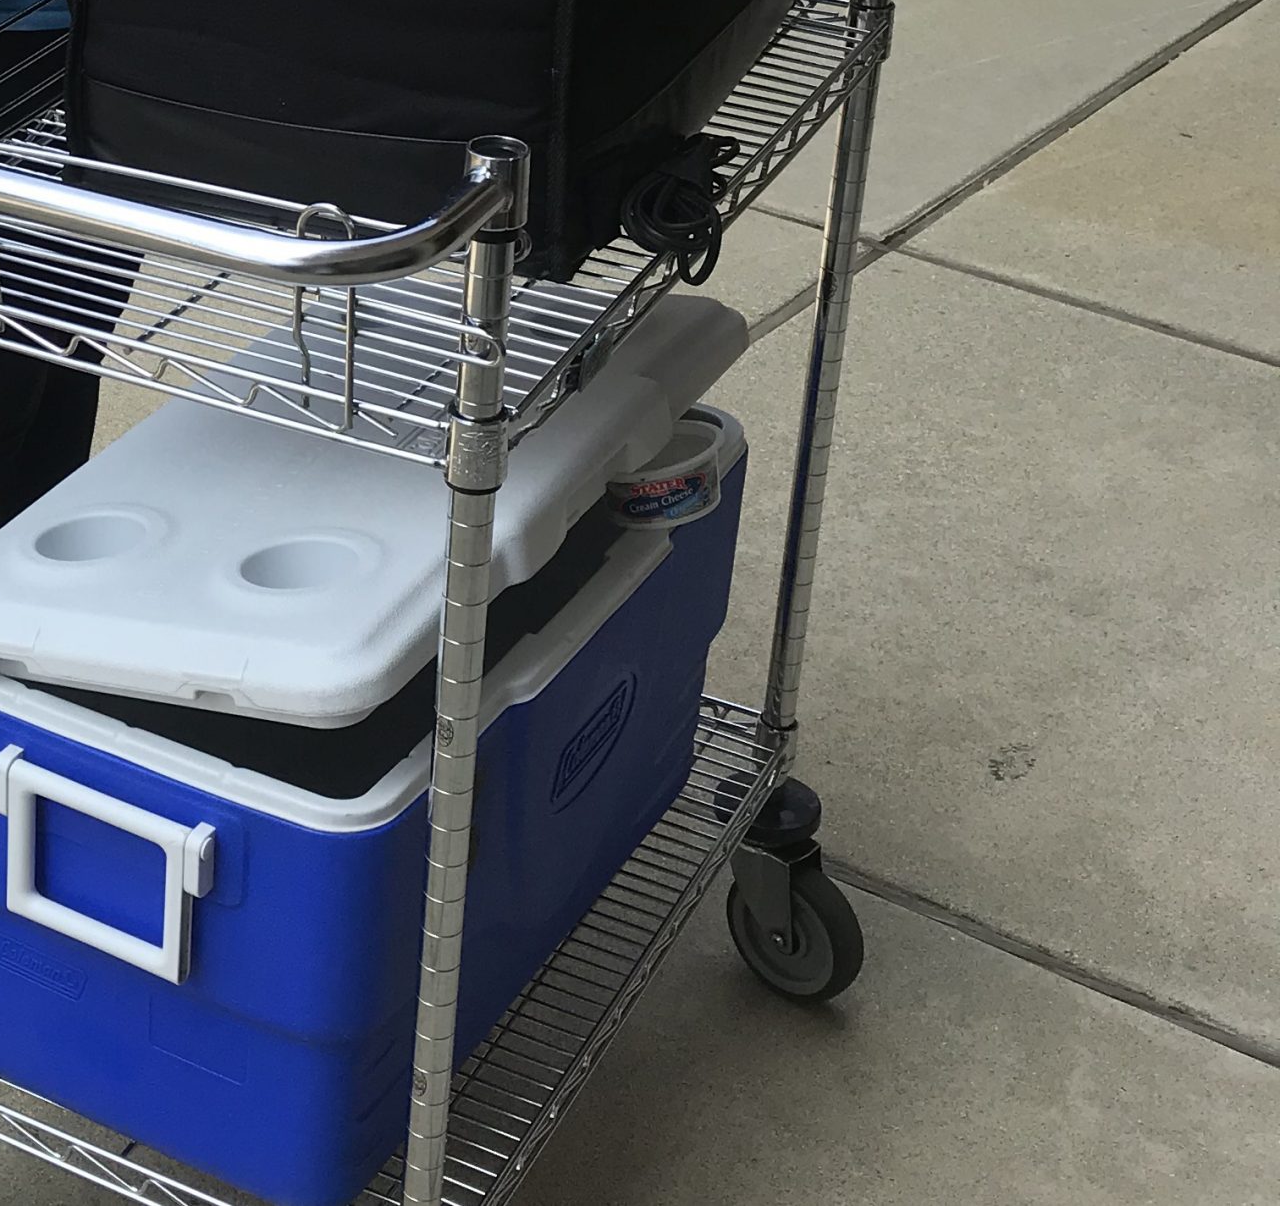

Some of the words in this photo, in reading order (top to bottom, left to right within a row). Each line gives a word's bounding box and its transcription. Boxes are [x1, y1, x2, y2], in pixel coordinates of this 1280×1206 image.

[630, 477, 687, 498] STATER
[629, 502, 659, 514] Cream
[661, 488, 694, 506] Cheese
